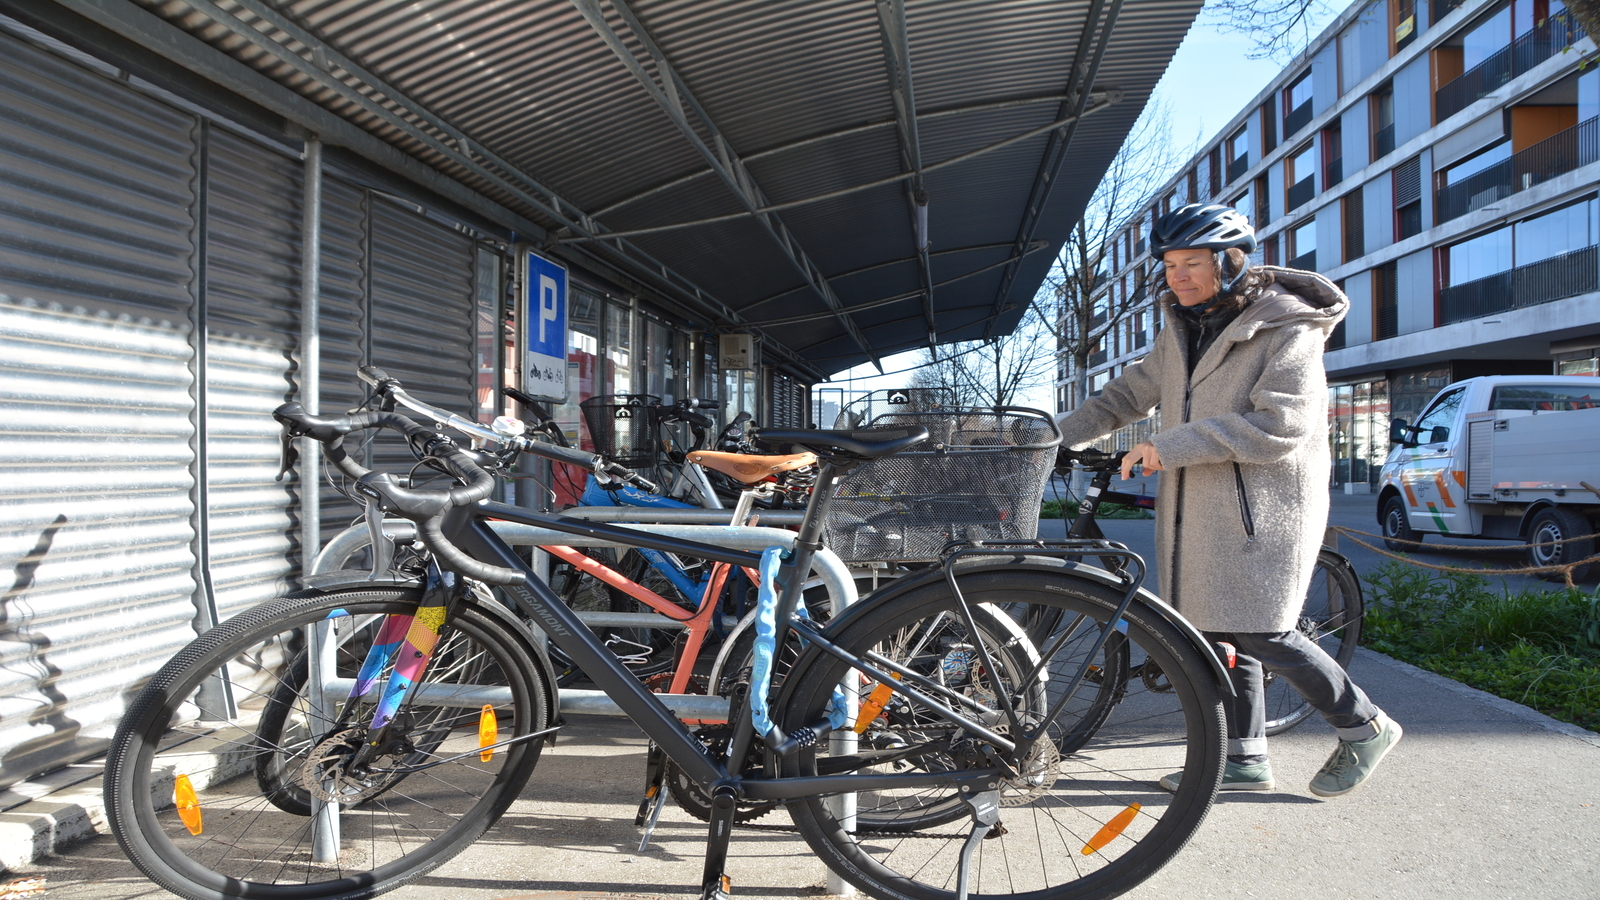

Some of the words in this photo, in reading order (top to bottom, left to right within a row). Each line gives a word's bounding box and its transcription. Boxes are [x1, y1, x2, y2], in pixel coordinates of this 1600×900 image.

[539, 274, 558, 344] P
[512, 585, 572, 638] ERGAMONT
[1044, 584, 1103, 604] SCHWALBE
